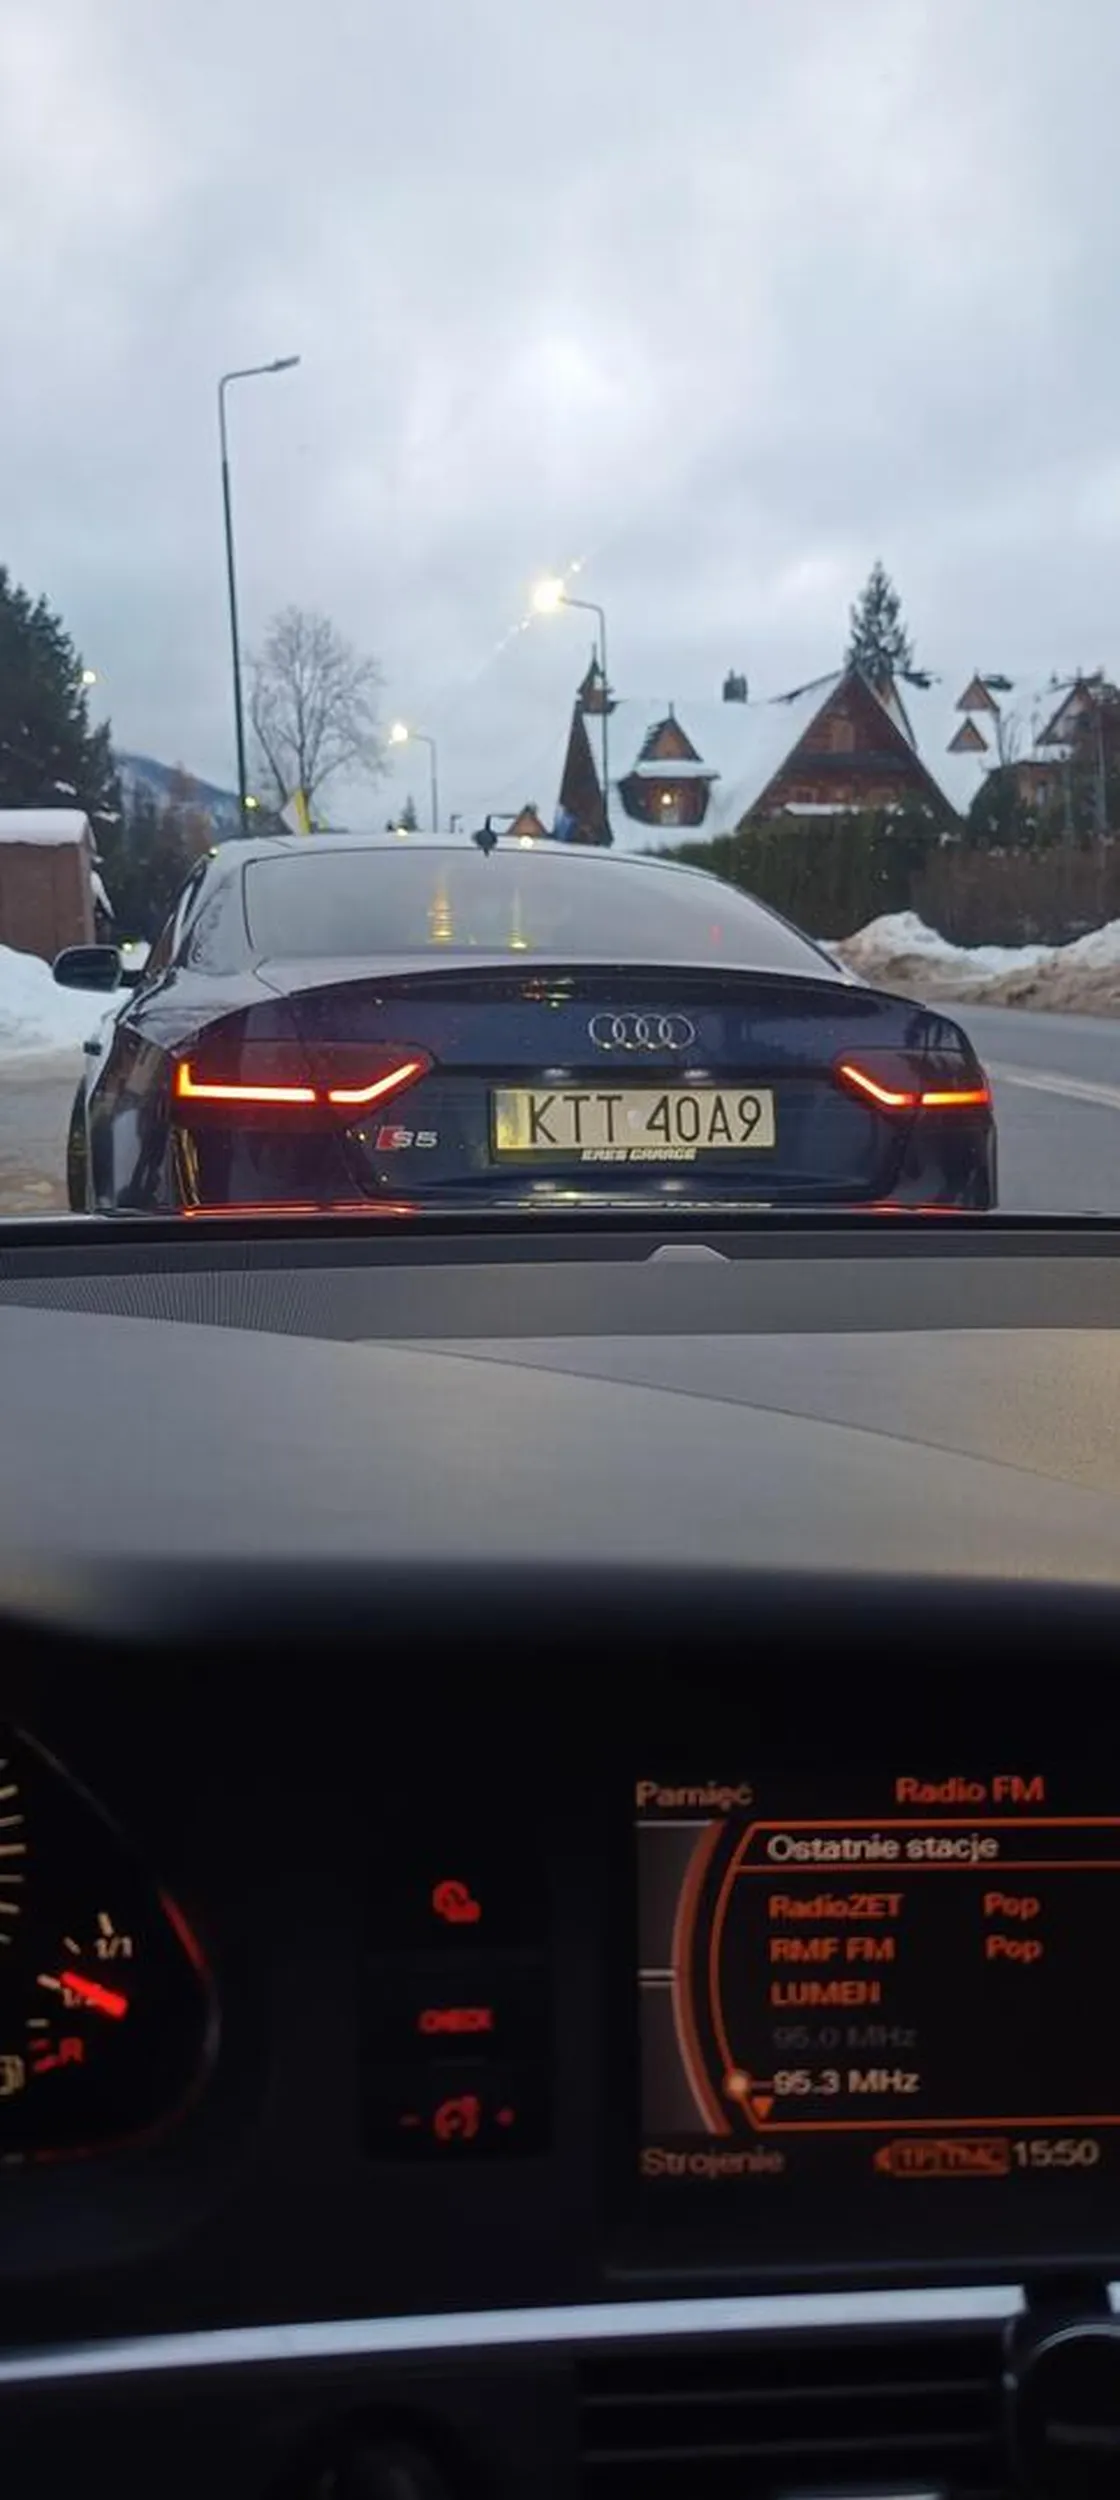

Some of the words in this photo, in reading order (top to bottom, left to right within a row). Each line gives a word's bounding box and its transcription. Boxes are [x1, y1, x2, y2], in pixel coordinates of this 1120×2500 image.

[530, 1095, 623, 1143] KTT
[647, 1095, 762, 1143] 40A9
[385, 1128, 438, 1149] S5
[636, 1781, 752, 1809] Pamięć
[896, 1777, 986, 1803] Radio
[992, 1777, 1044, 1801] FM
[767, 1835, 898, 1861] Ostatnie
[906, 1833, 999, 1862] stacje
[769, 1894, 903, 1919] RadioZET
[984, 1893, 1040, 1919] Pop
[770, 1938, 839, 1962] RMF
[847, 1938, 895, 1961] FM
[986, 1935, 1042, 1962] Pop
[770, 1982, 881, 2006] LUMEN
[773, 2070, 841, 2095] 95.3
[848, 2069, 920, 2093] MHz
[641, 2147, 784, 2178] Strojenie
[1012, 2139, 1099, 2167] 15:50
